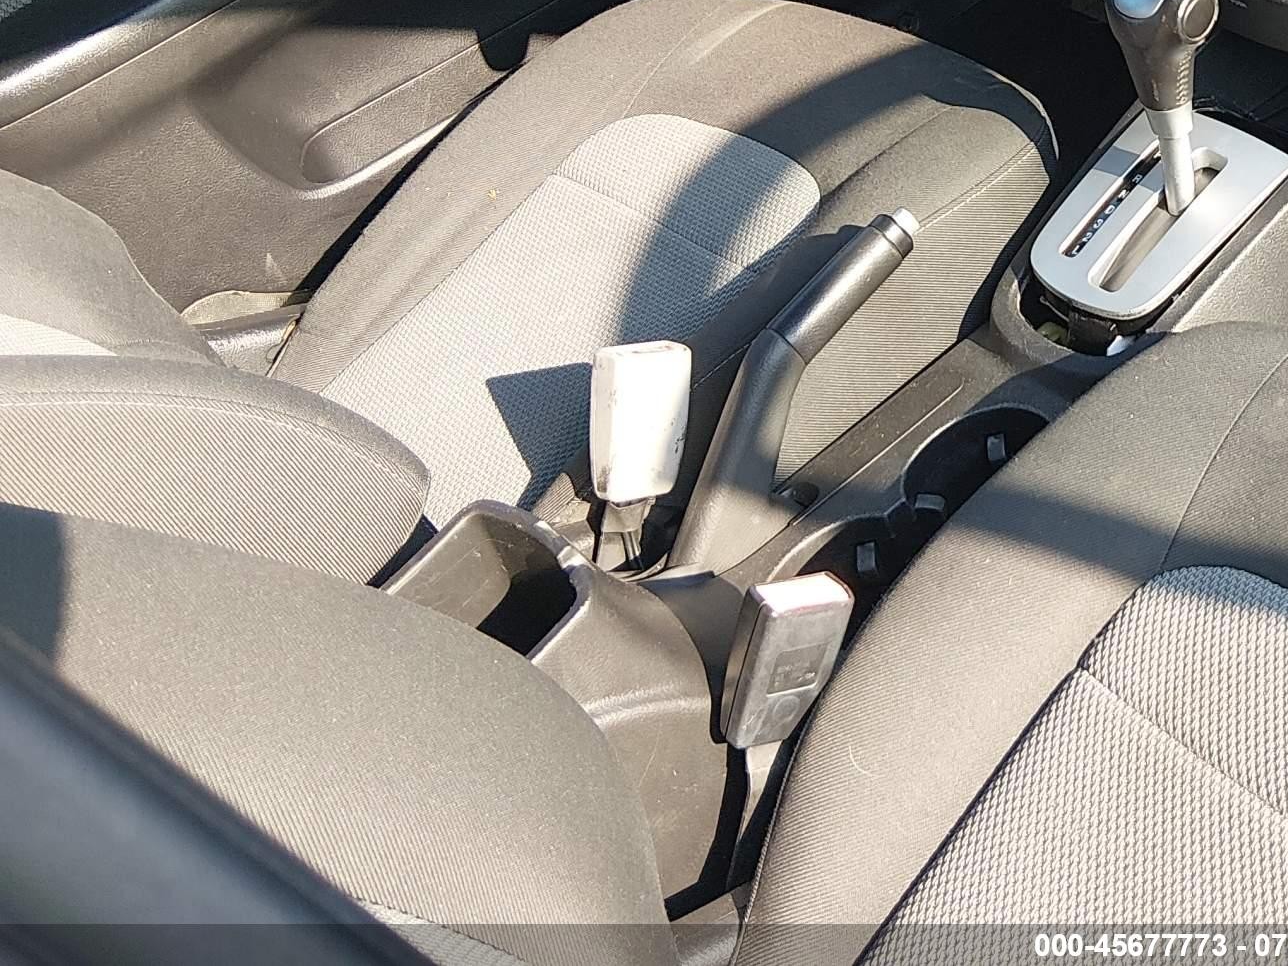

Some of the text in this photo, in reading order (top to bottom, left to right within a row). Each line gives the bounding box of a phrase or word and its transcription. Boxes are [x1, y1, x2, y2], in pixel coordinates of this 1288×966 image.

[1131, 174, 1143, 183] R
[1118, 189, 1131, 199] N
[1104, 204, 1116, 214] D
[1082, 232, 1095, 242] 2
